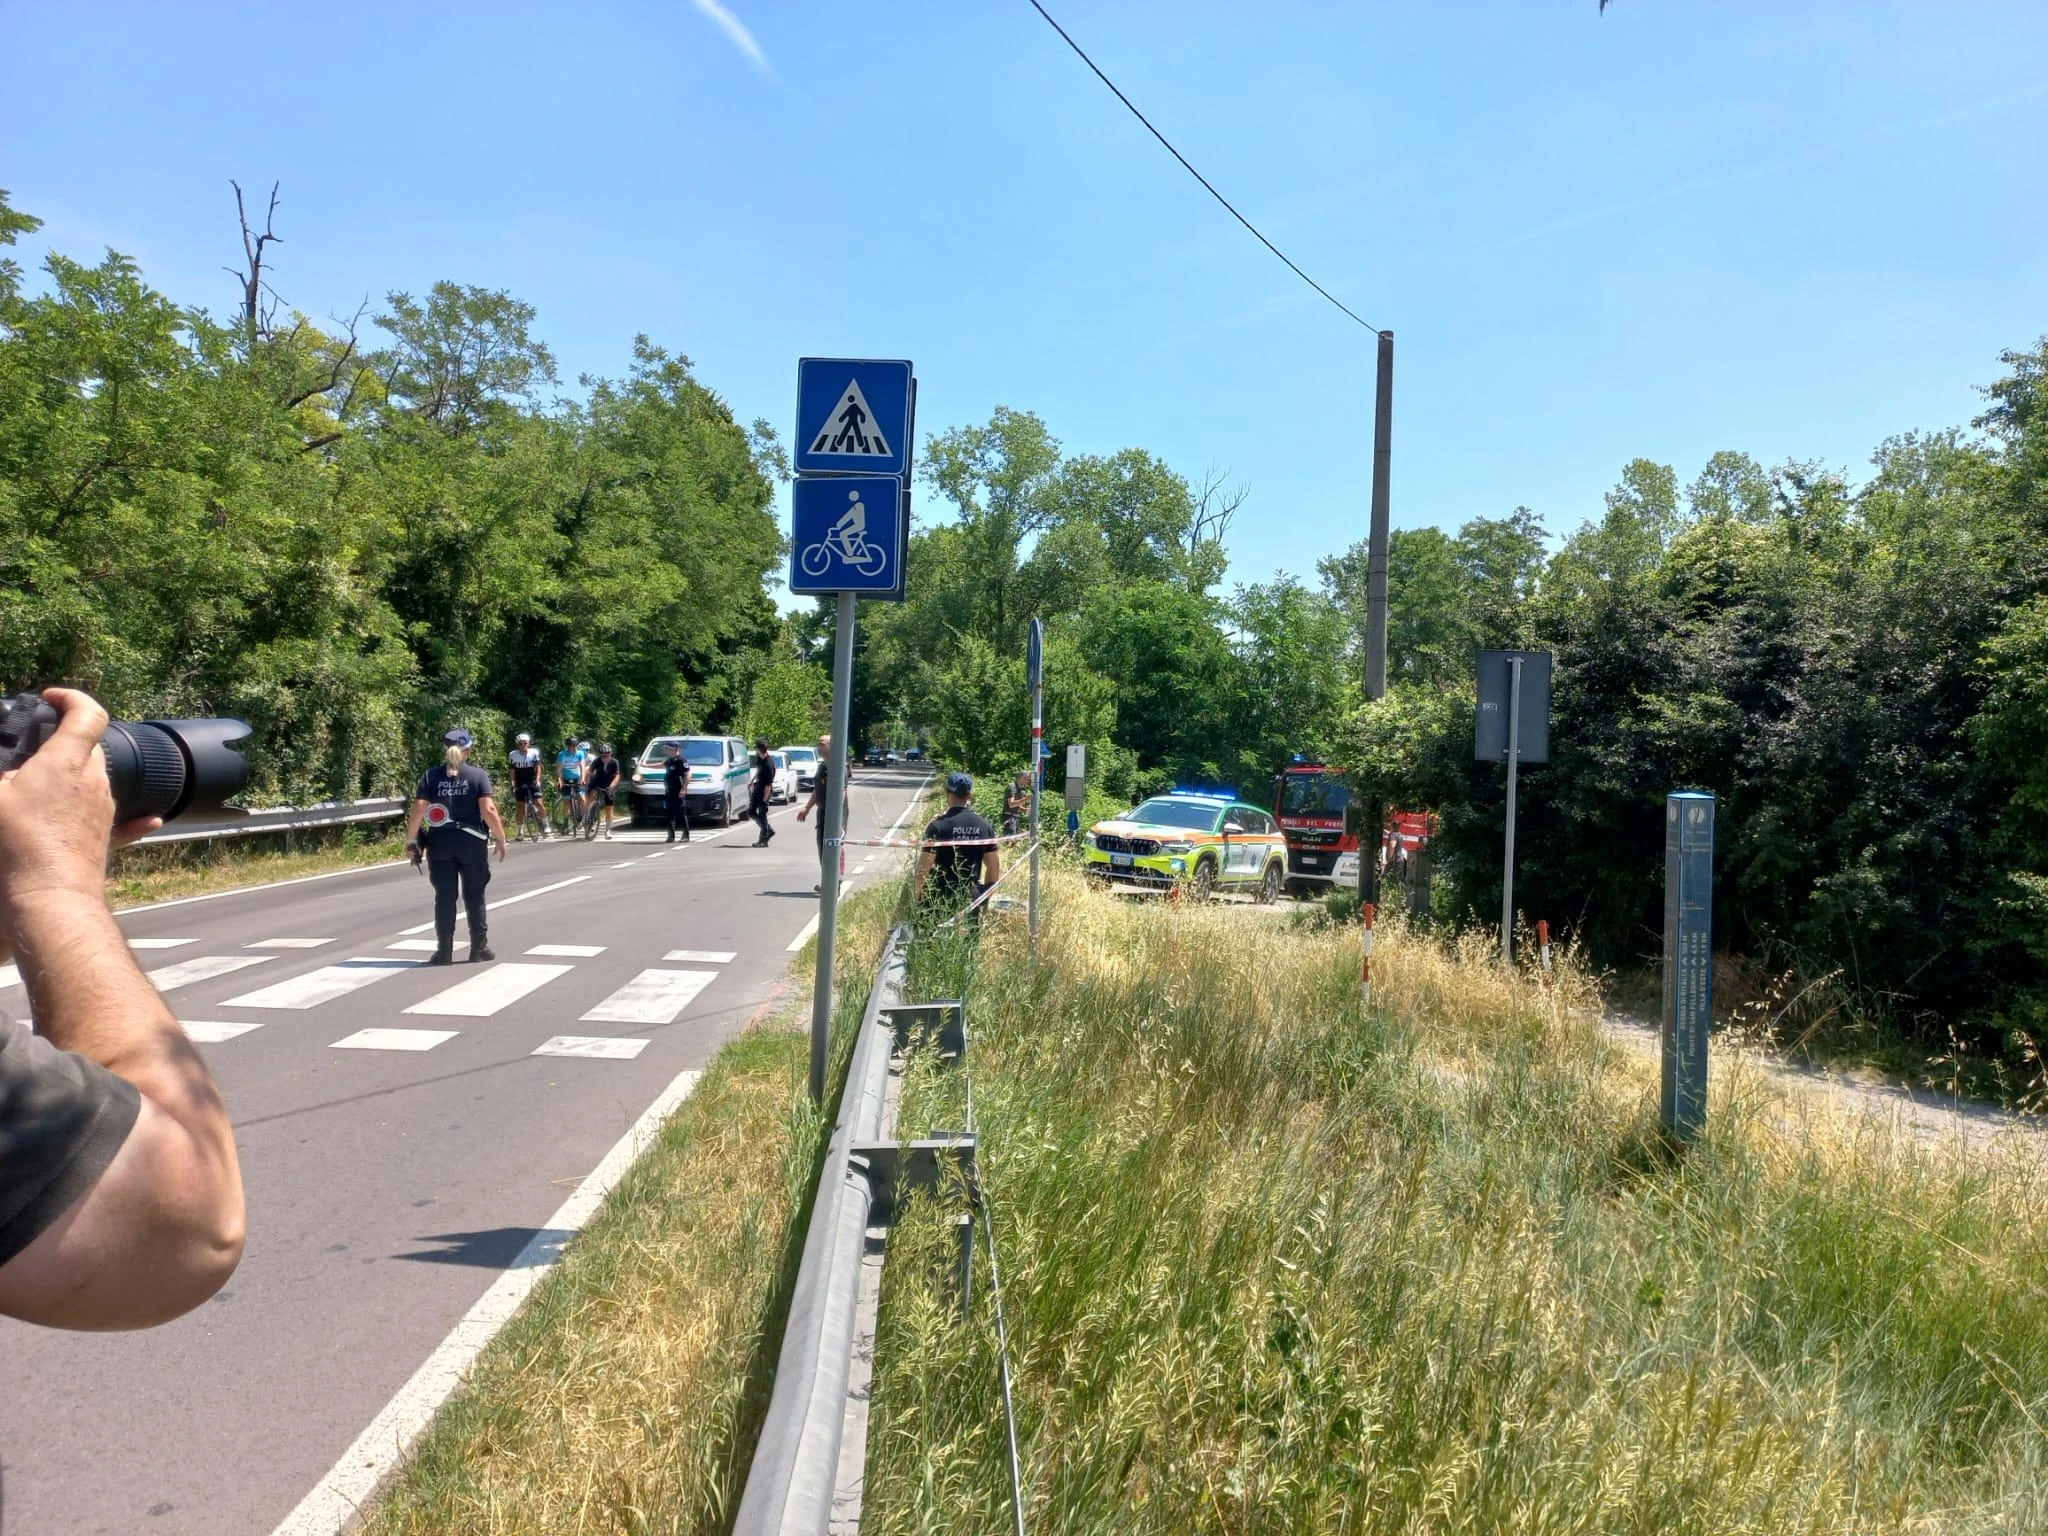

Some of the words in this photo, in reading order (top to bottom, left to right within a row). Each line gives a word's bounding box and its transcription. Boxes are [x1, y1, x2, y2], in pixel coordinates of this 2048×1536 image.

[438, 780, 468, 789] POLIZIA
[438, 788, 468, 797] LOCALE
[952, 826, 980, 835] POLIZIA
[1691, 932, 1698, 944] KM
[1700, 932, 1708, 944] KM
[1680, 968, 1688, 997] RIVALTA
[1689, 1010, 1697, 1025] SAN
[1688, 1034, 1696, 1057] PONTE
